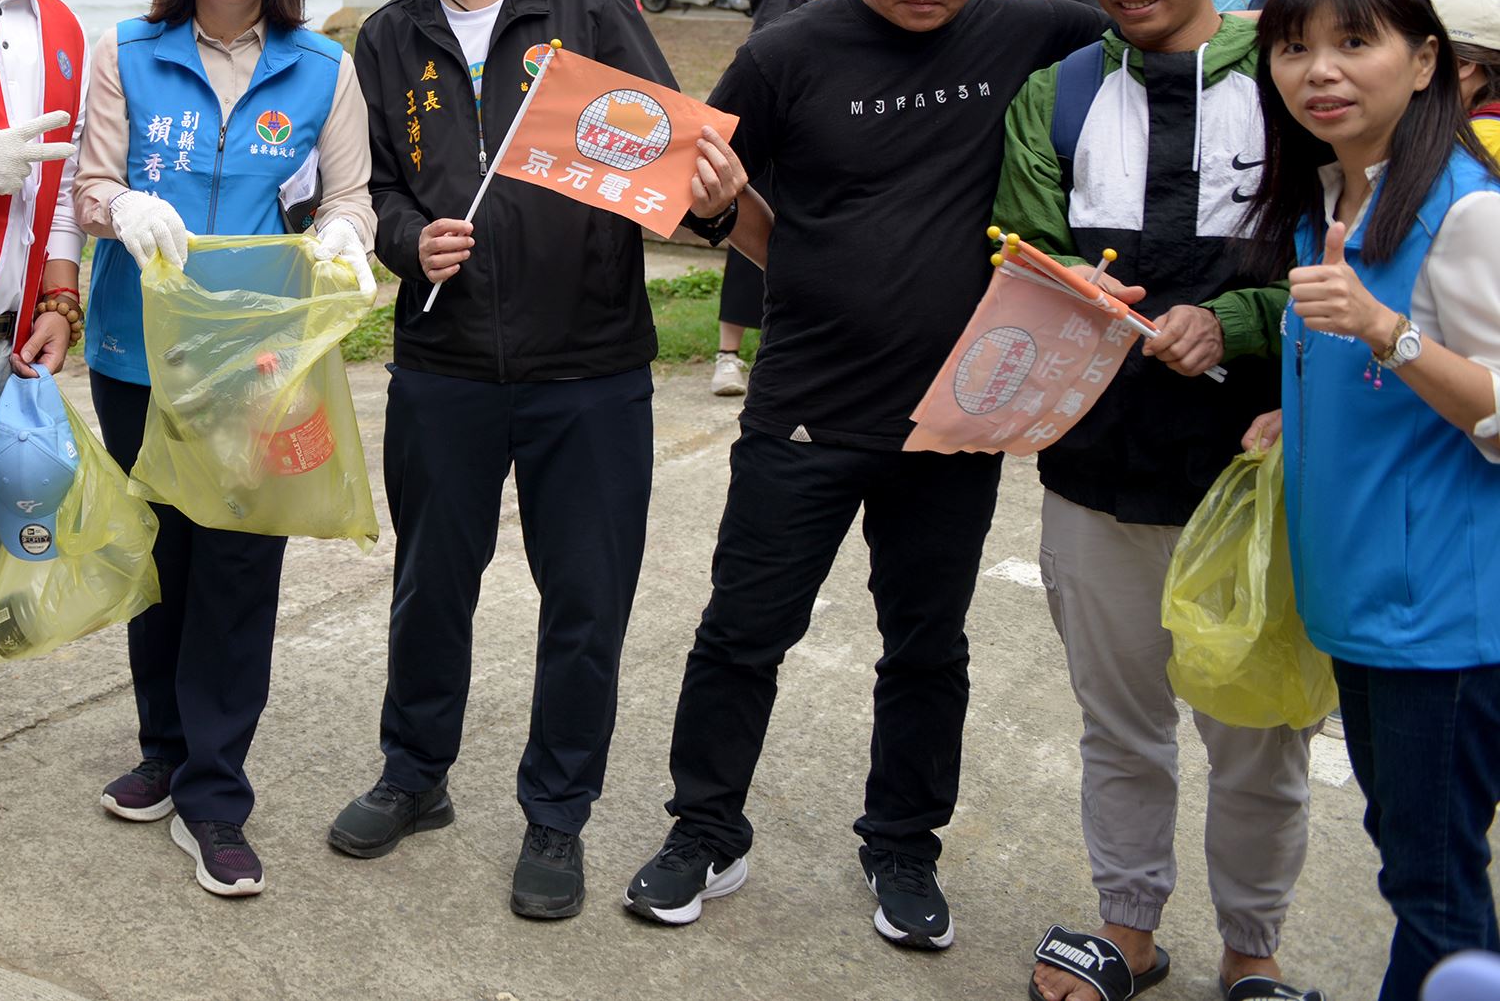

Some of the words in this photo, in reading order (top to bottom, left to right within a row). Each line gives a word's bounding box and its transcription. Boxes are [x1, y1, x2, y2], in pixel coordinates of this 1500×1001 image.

[142, 115, 173, 199] 賴香
[173, 111, 200, 172] 副縣長
[580, 123, 662, 162] KYEC
[520, 147, 668, 215] 京元電子
[1045, 939, 1096, 969] PUMA
